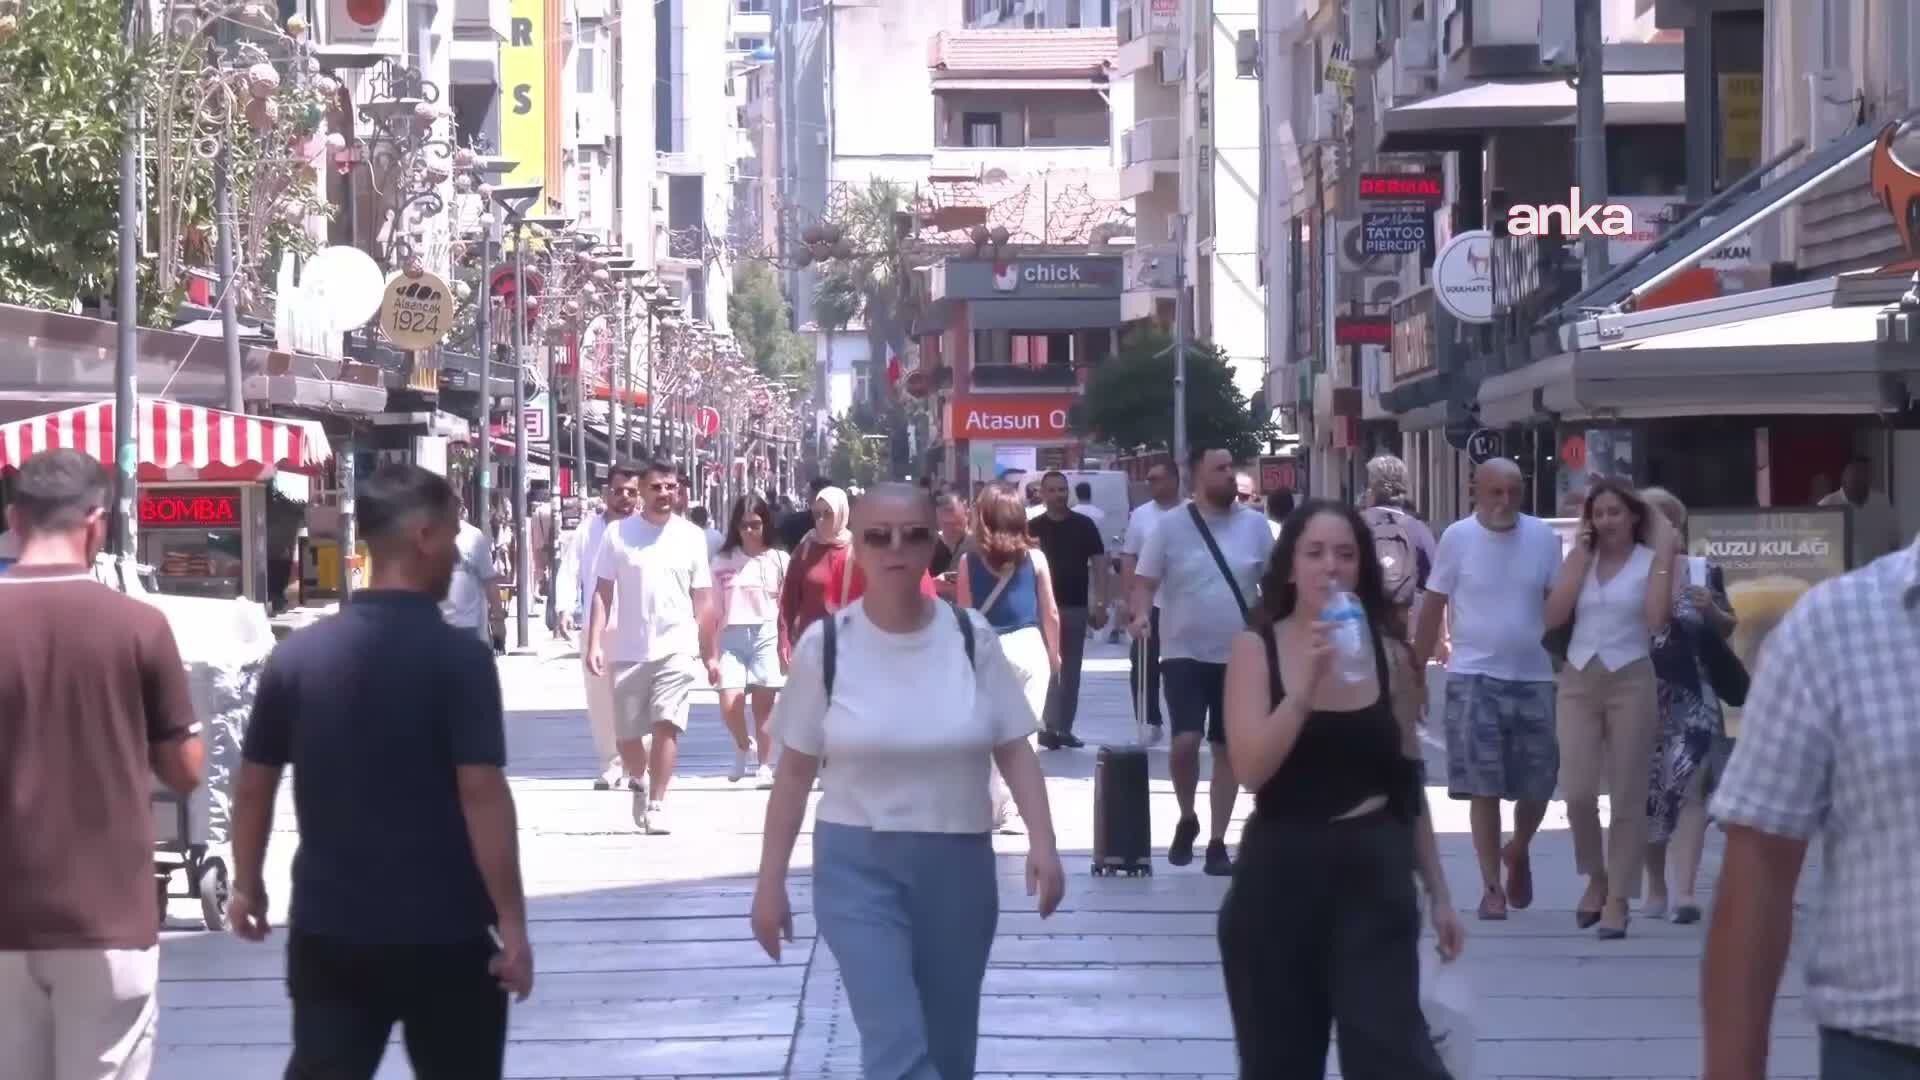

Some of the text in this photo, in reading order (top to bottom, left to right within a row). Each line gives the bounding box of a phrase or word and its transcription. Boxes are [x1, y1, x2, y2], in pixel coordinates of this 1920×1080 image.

[1366, 227, 1425, 239] TATTOO
[1024, 264, 1080, 281] chick
[393, 310, 439, 335] 1924
[965, 409, 1066, 430] Atasun O
[142, 497, 233, 521] BOMBA
[1705, 541, 1756, 556] KUZU
